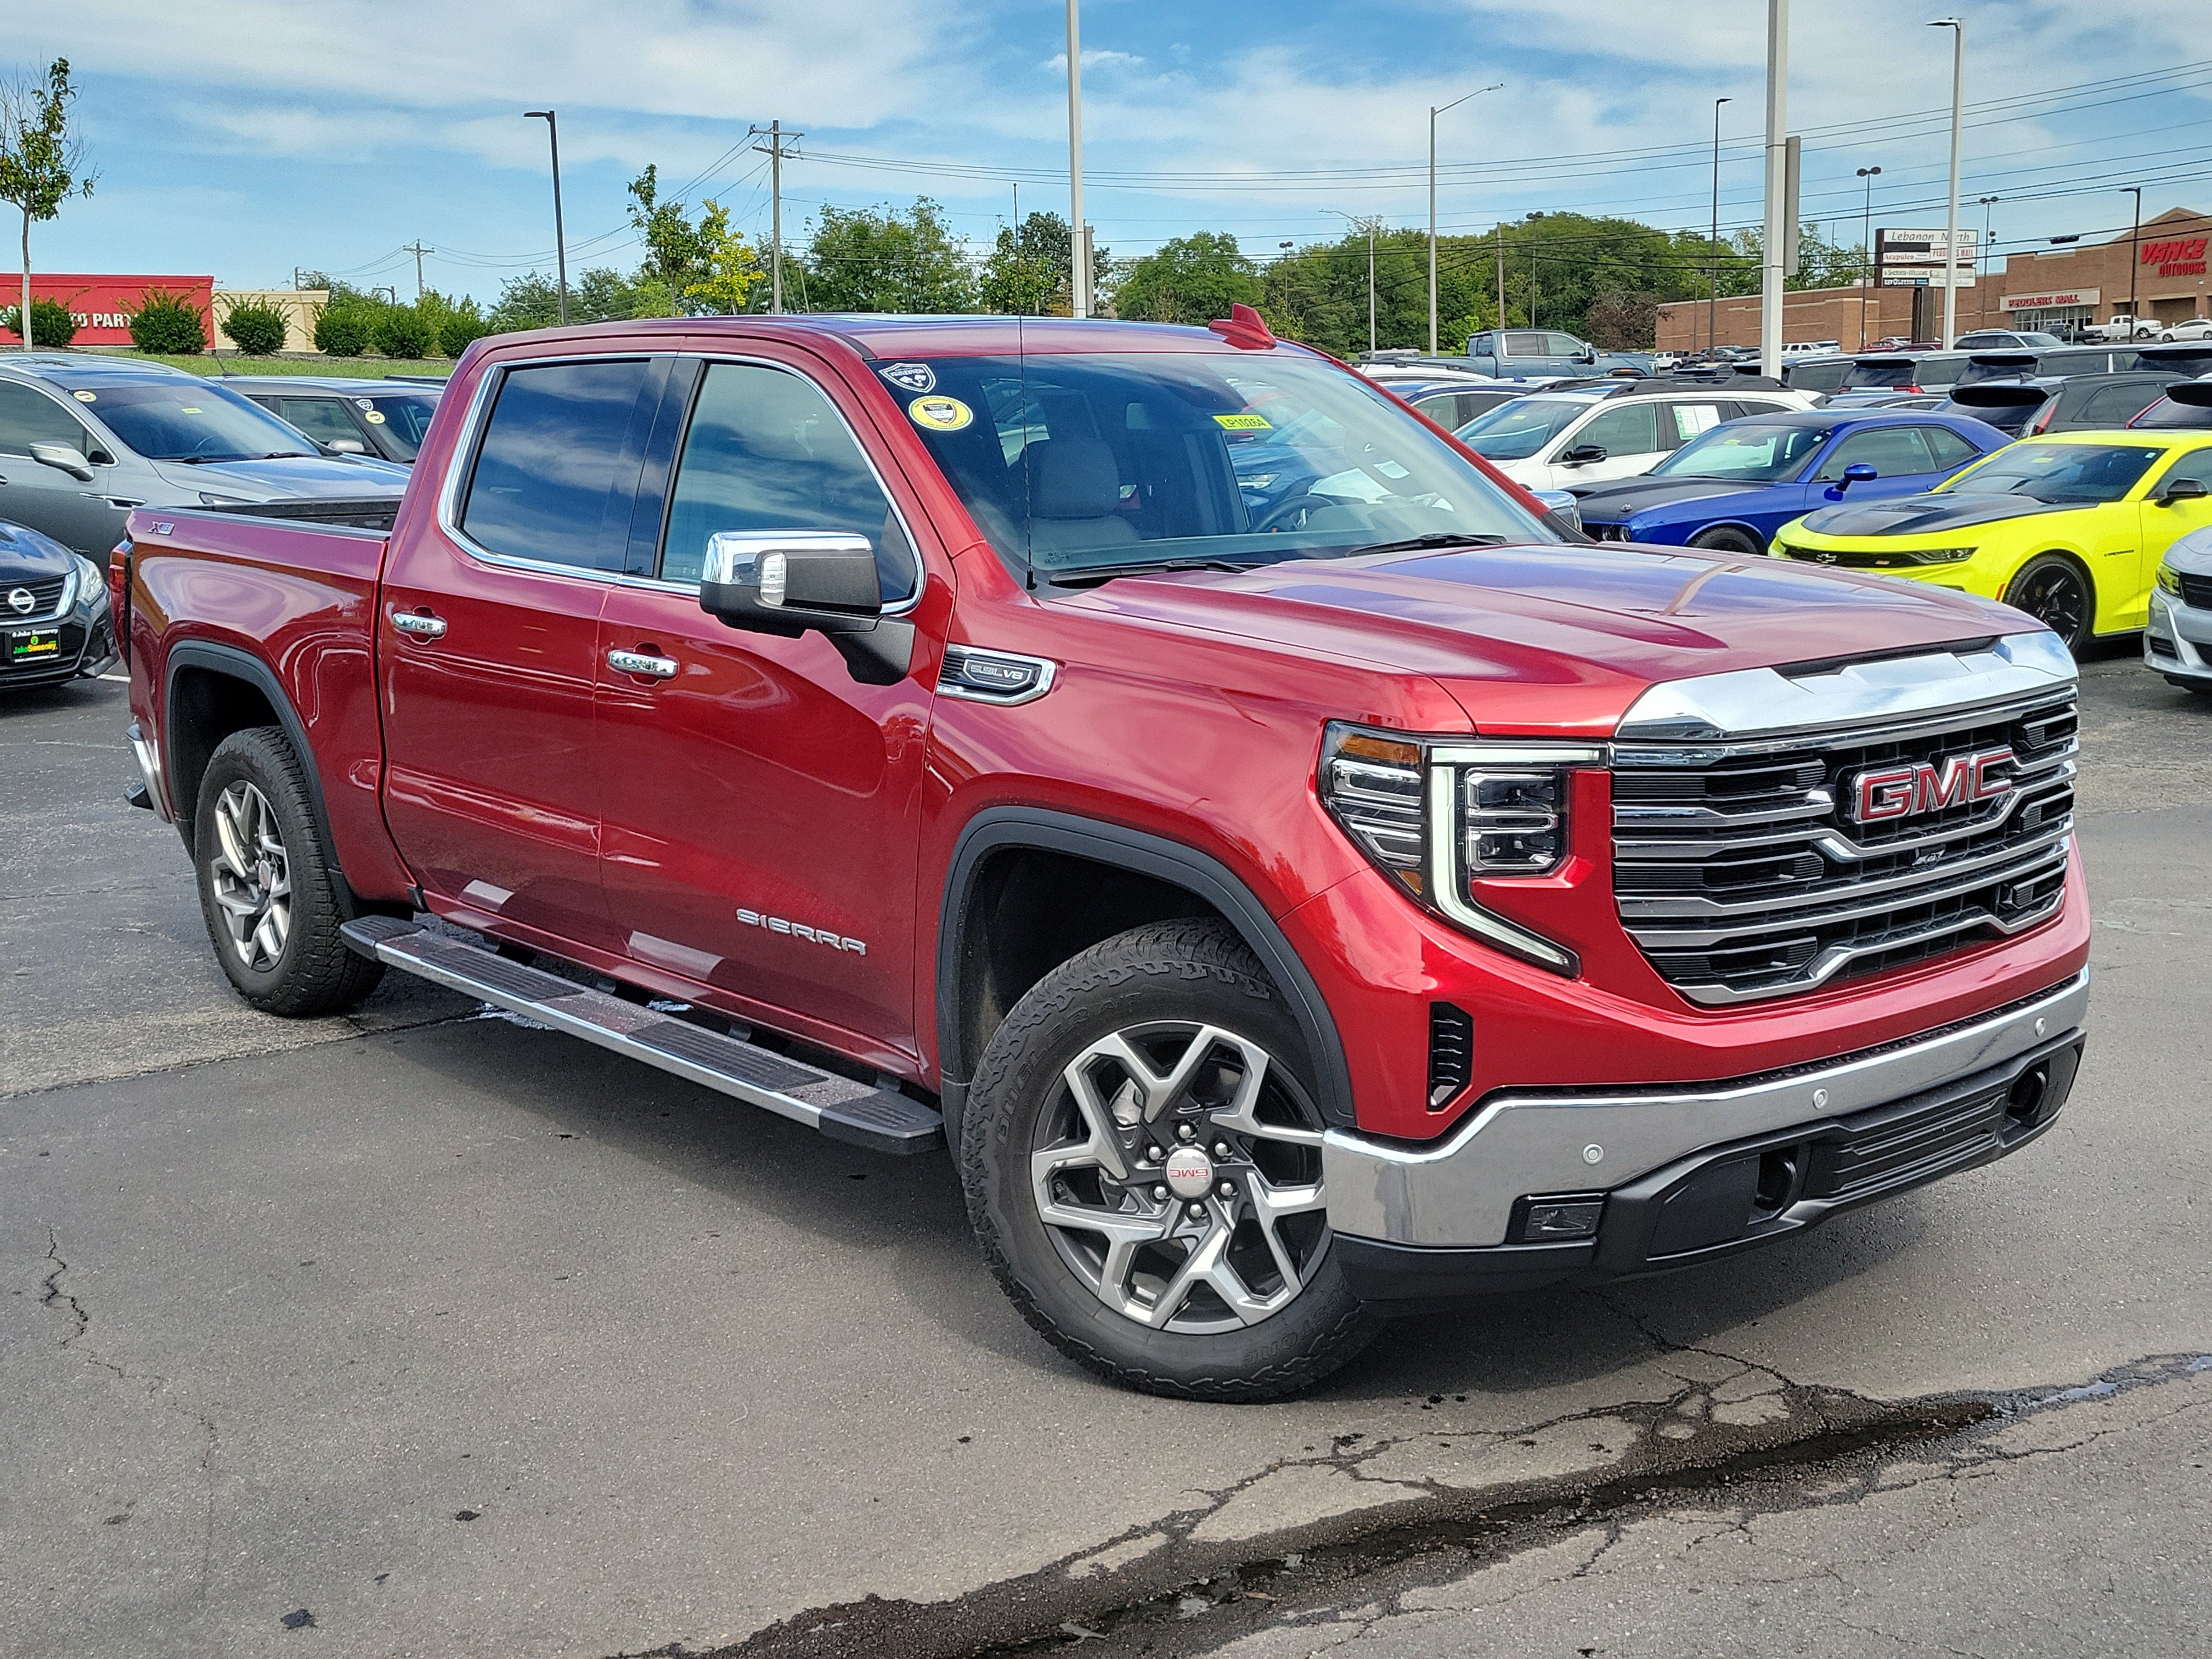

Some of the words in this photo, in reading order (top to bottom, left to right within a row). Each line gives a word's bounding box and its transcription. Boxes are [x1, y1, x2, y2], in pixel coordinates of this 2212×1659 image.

[1892, 231, 1934, 241] Lebanon
[1940, 232, 1970, 241] Nth
[2141, 239, 2208, 265] VANCE
[2159, 261, 2207, 277] OUTDOORS
[2056, 295, 2080, 304] MALL
[93, 313, 140, 328] PART
[1003, 669, 1024, 680] V8
[1853, 746, 2013, 824] GMC
[736, 909, 866, 956] SIERRA
[1170, 1168, 1208, 1178] GMC
